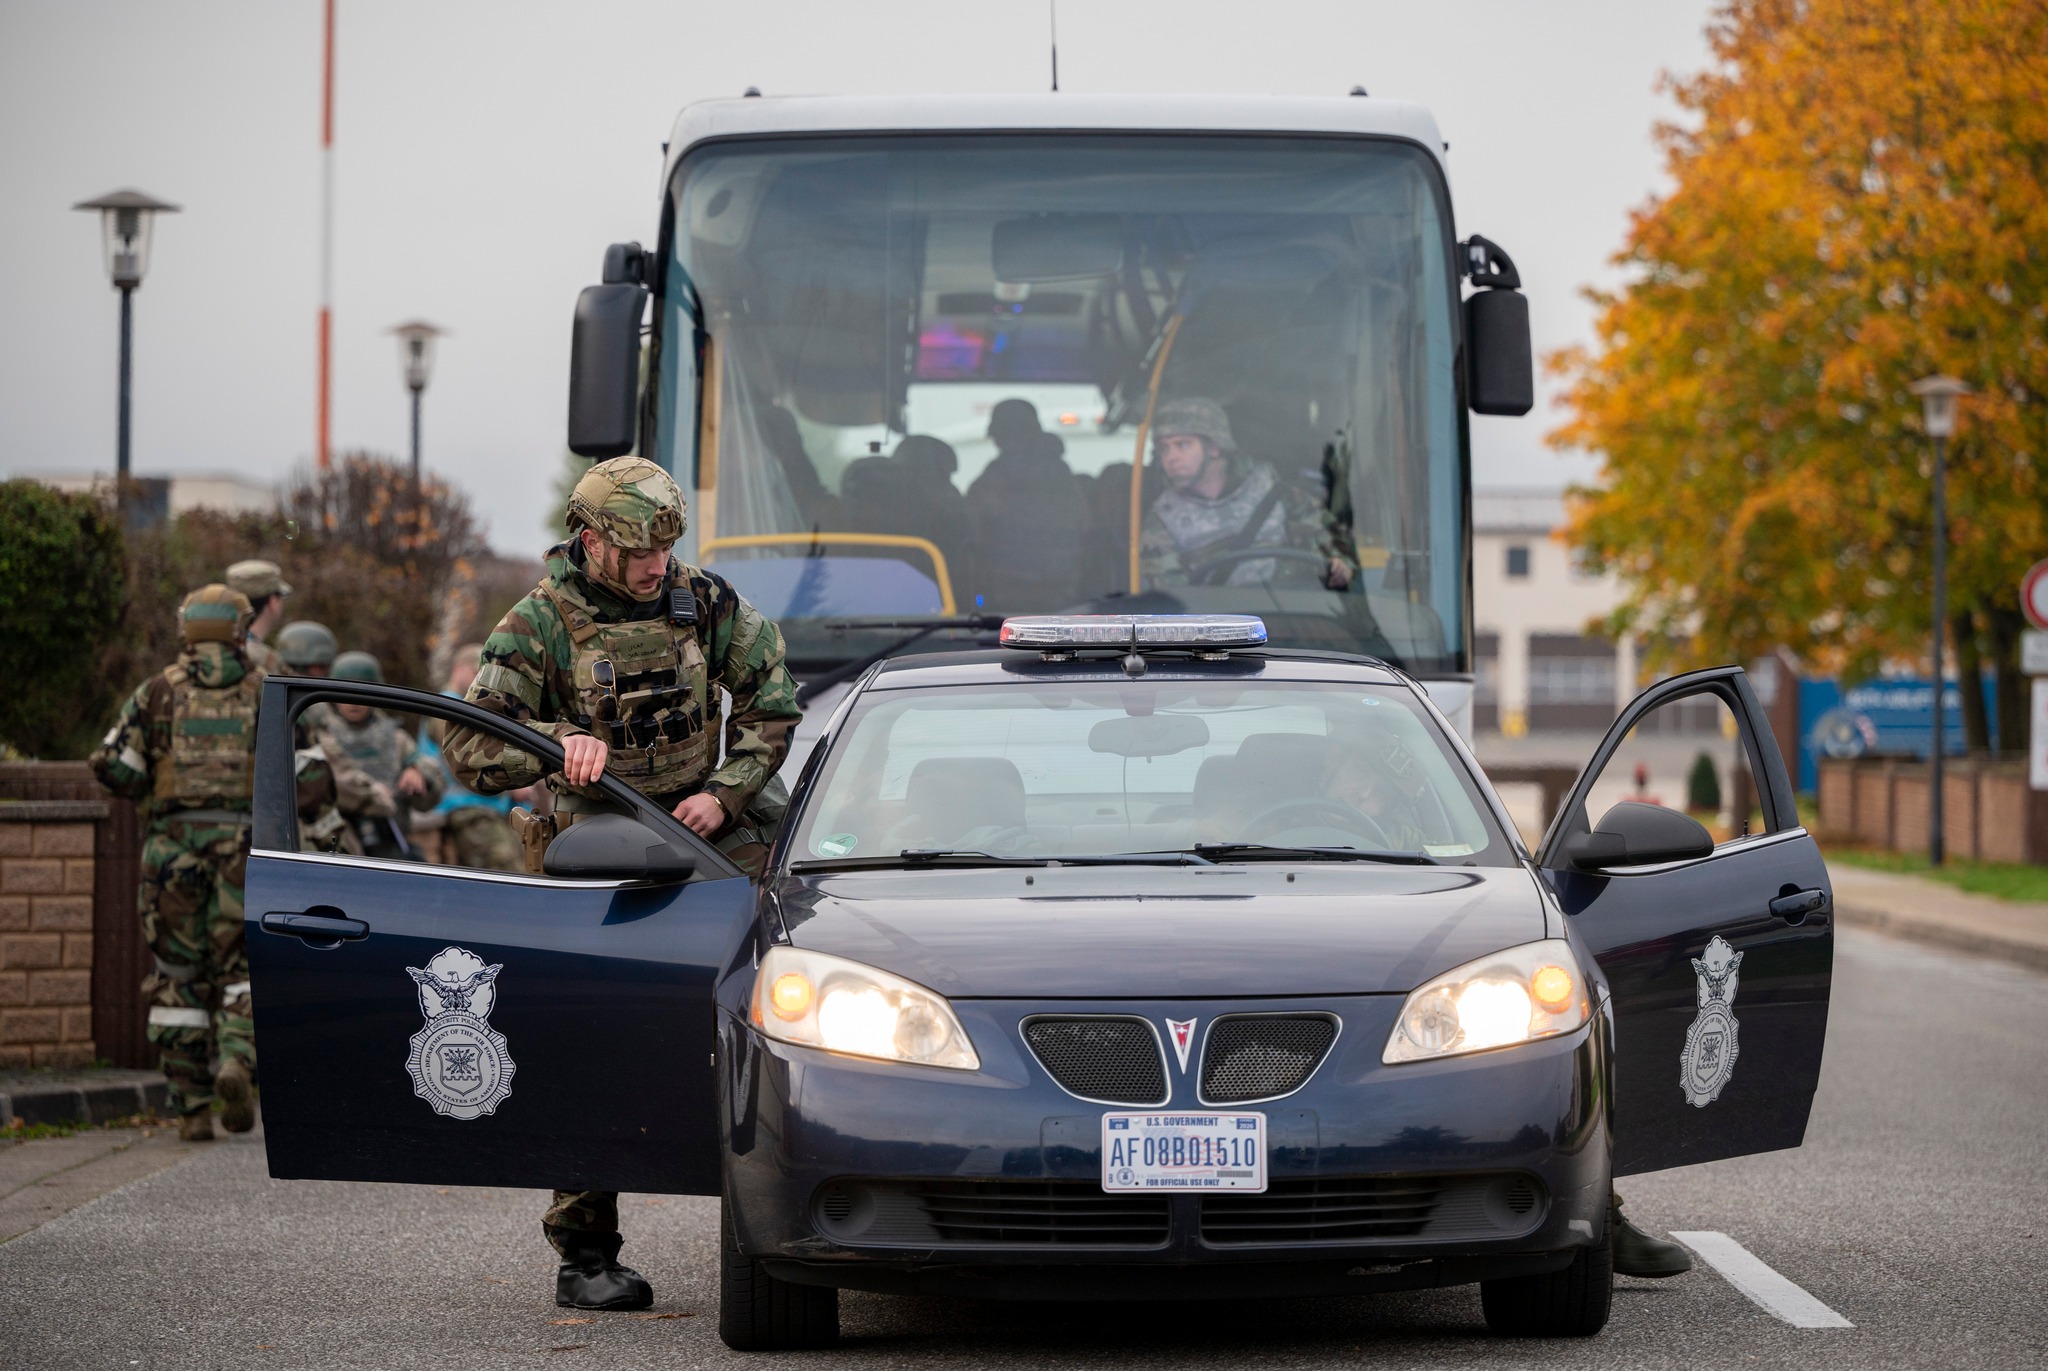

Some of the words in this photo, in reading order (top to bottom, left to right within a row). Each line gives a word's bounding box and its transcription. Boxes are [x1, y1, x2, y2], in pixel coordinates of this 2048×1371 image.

[432, 1017, 459, 1030] SECURITY
[461, 1018, 481, 1029] POLICE
[426, 1030, 449, 1068] DEPARTMENT
[460, 1029, 474, 1038] THE
[474, 1036, 485, 1047] AIR
[484, 1046, 496, 1068] FORCE
[427, 1073, 442, 1095] UNITED
[443, 1094, 468, 1103] STATES
[480, 1073, 496, 1098] AMERICA
[1146, 1117, 1160, 1126] U.S.
[1164, 1117, 1218, 1126] GOVERNMENT
[1110, 1137, 1256, 1167] AF08B01510
